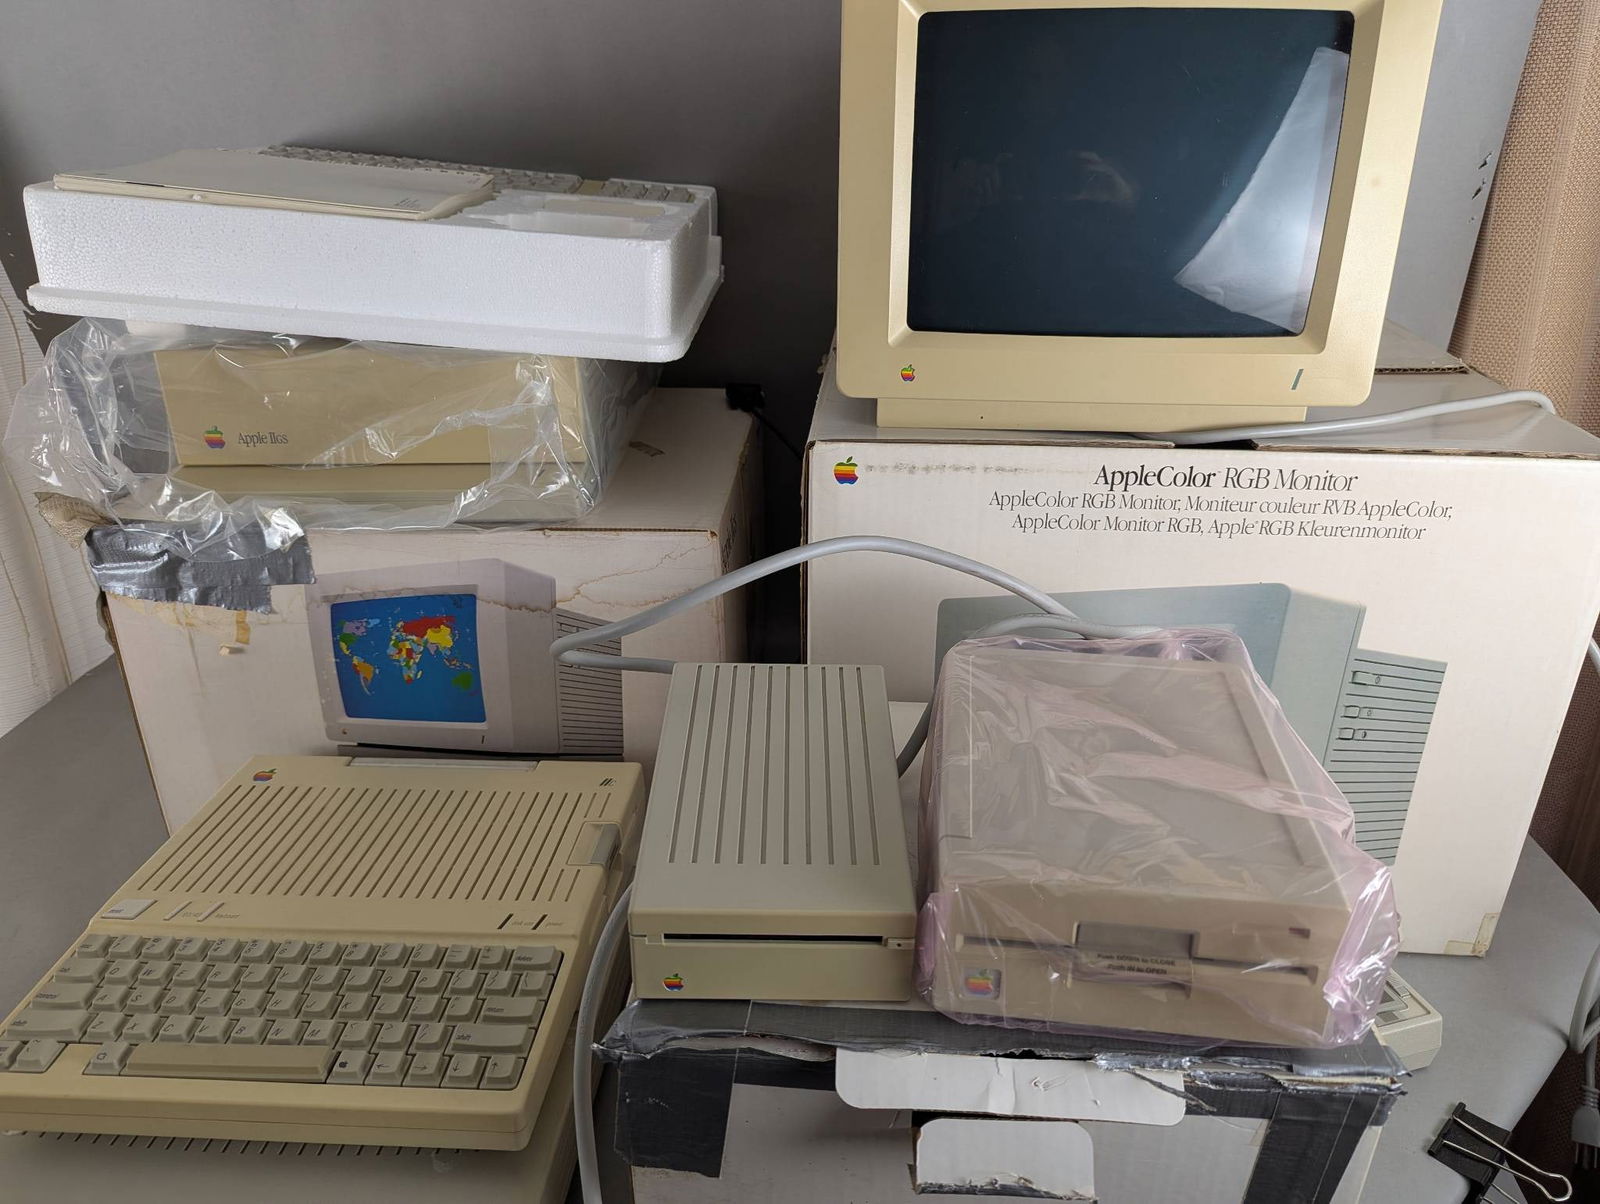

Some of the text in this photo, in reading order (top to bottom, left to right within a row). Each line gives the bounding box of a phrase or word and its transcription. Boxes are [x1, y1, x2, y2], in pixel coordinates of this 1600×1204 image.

[238, 431, 267, 447] Apple
[1093, 464, 1359, 492] AppleColor RGB Monitor
[989, 490, 1453, 521] AppleColor RGB Monitor, Moniteur couleur RVB AppleColor,
[1012, 513, 1101, 534] AppleColor
[1103, 515, 1165, 533] Monitor
[1167, 517, 1204, 536] RGB,
[1258, 519, 1294, 536] RGB
[1297, 520, 1427, 540] Kleurenmonitor
